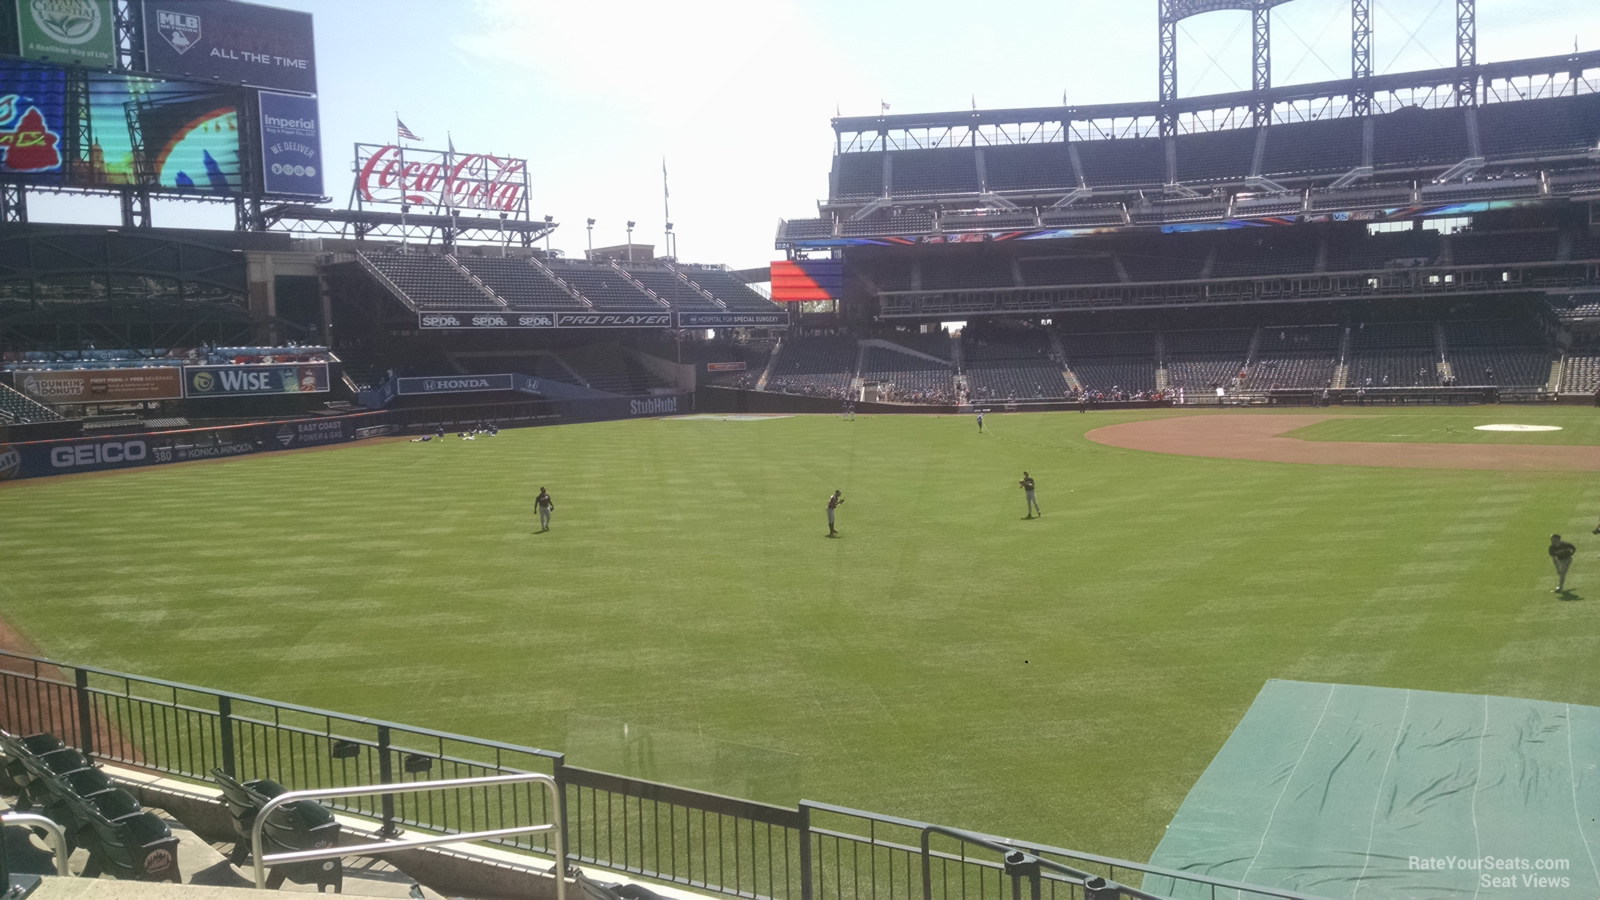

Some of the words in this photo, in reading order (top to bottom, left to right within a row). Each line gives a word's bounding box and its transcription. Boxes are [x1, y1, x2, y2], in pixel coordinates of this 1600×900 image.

[160, 13, 198, 28] MLB
[160, 24, 198, 33] NETWORK
[210, 47, 239, 60] ALL
[241, 51, 271, 64] THE
[273, 56, 307, 69] TIME
[265, 114, 314, 129] Imperial
[270, 142, 283, 155] WE
[283, 141, 315, 158] DELIVER
[559, 315, 600, 324] PRO
[600, 315, 670, 324] PLAYER
[41, 380, 83, 388] DUNKIN'
[437, 379, 490, 389] HONDA
[41, 387, 82, 395] DONUTS
[630, 397, 677, 414] StubHub!
[298, 424, 318, 432] EAST
[318, 421, 342, 430] COAST
[298, 433, 324, 441] POWER
[329, 431, 343, 439] GAS
[51, 440, 147, 468] GEICO
[188, 447, 219, 458] KONICA
[220, 443, 253, 453] MINOLTA
[155, 451, 172, 462] 380
